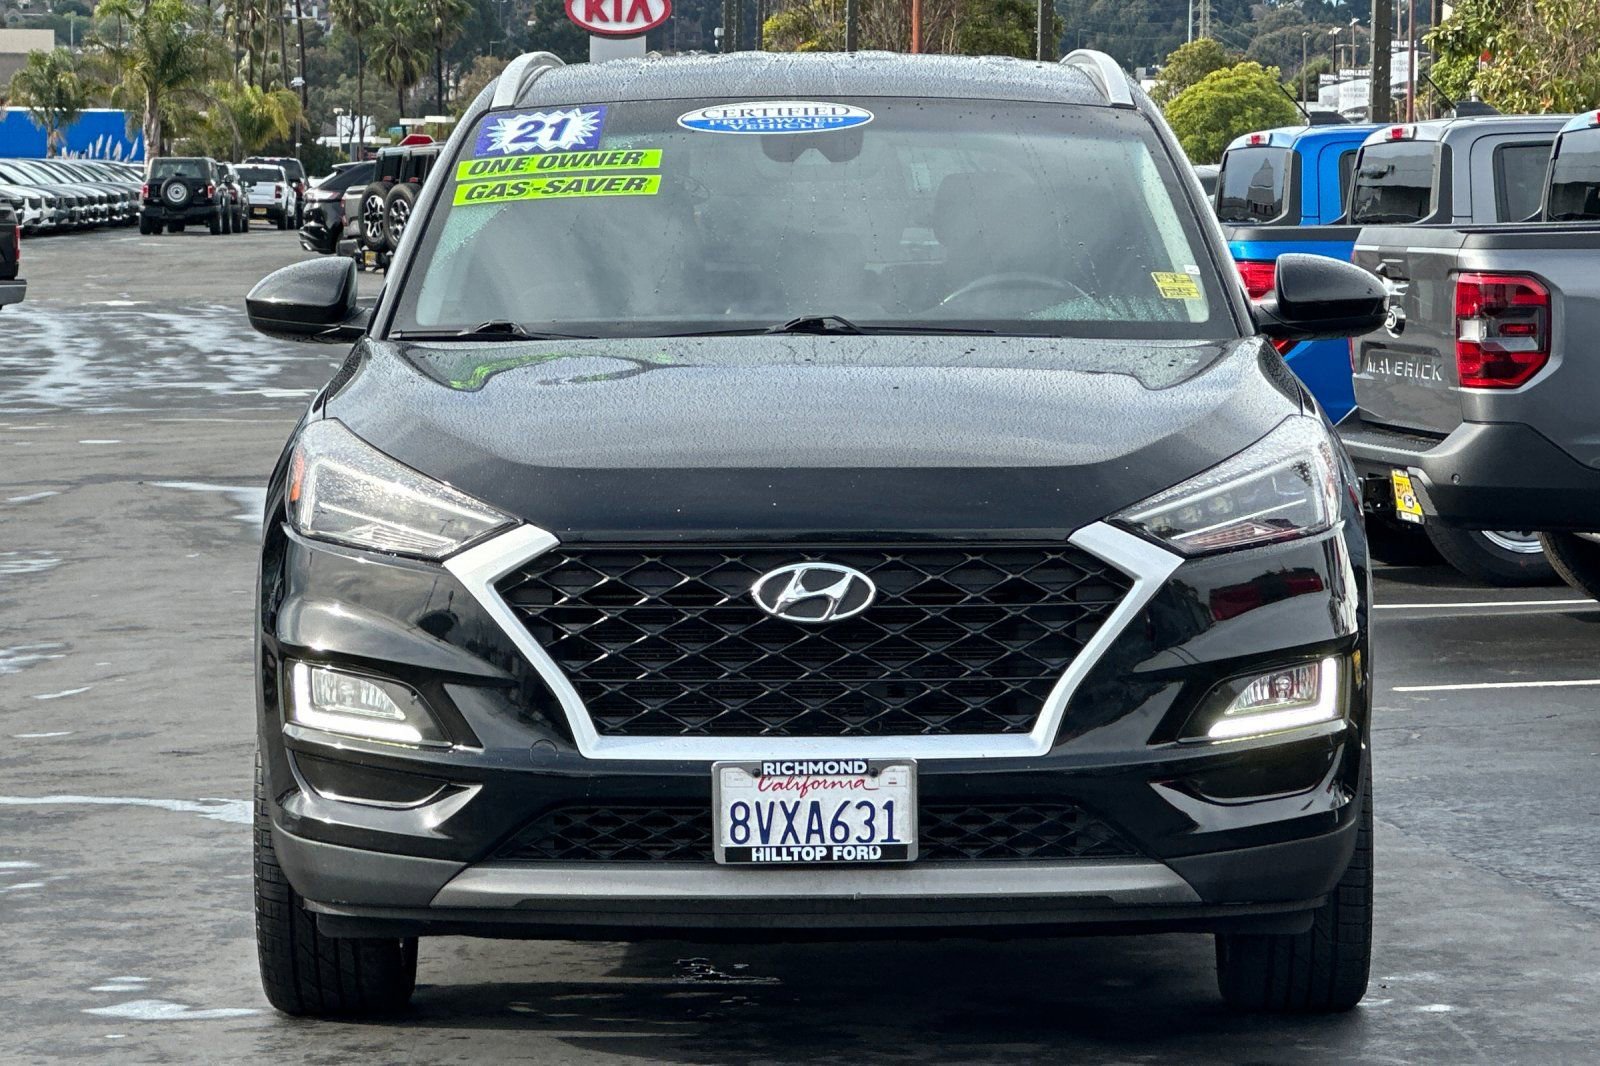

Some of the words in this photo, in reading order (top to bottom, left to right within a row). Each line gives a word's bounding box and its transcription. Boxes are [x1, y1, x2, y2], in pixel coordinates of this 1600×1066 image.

[585, 0, 653, 23] KIA
[701, 107, 850, 119] CERTIFIED
[709, 117, 844, 126] PRE-OWNED
[506, 117, 572, 145] 21
[729, 122, 825, 131] VEHICLE
[468, 156, 531, 176] ONE
[536, 151, 645, 170] OWNER
[465, 177, 648, 200] GAS-SAVER
[1367, 356, 1442, 382] MAVERICK
[762, 761, 868, 776] RICHMOND
[757, 774, 880, 799] California
[729, 800, 901, 845] 8VXA631
[751, 846, 827, 862] HILLTOP
[833, 845, 881, 861] FORD
